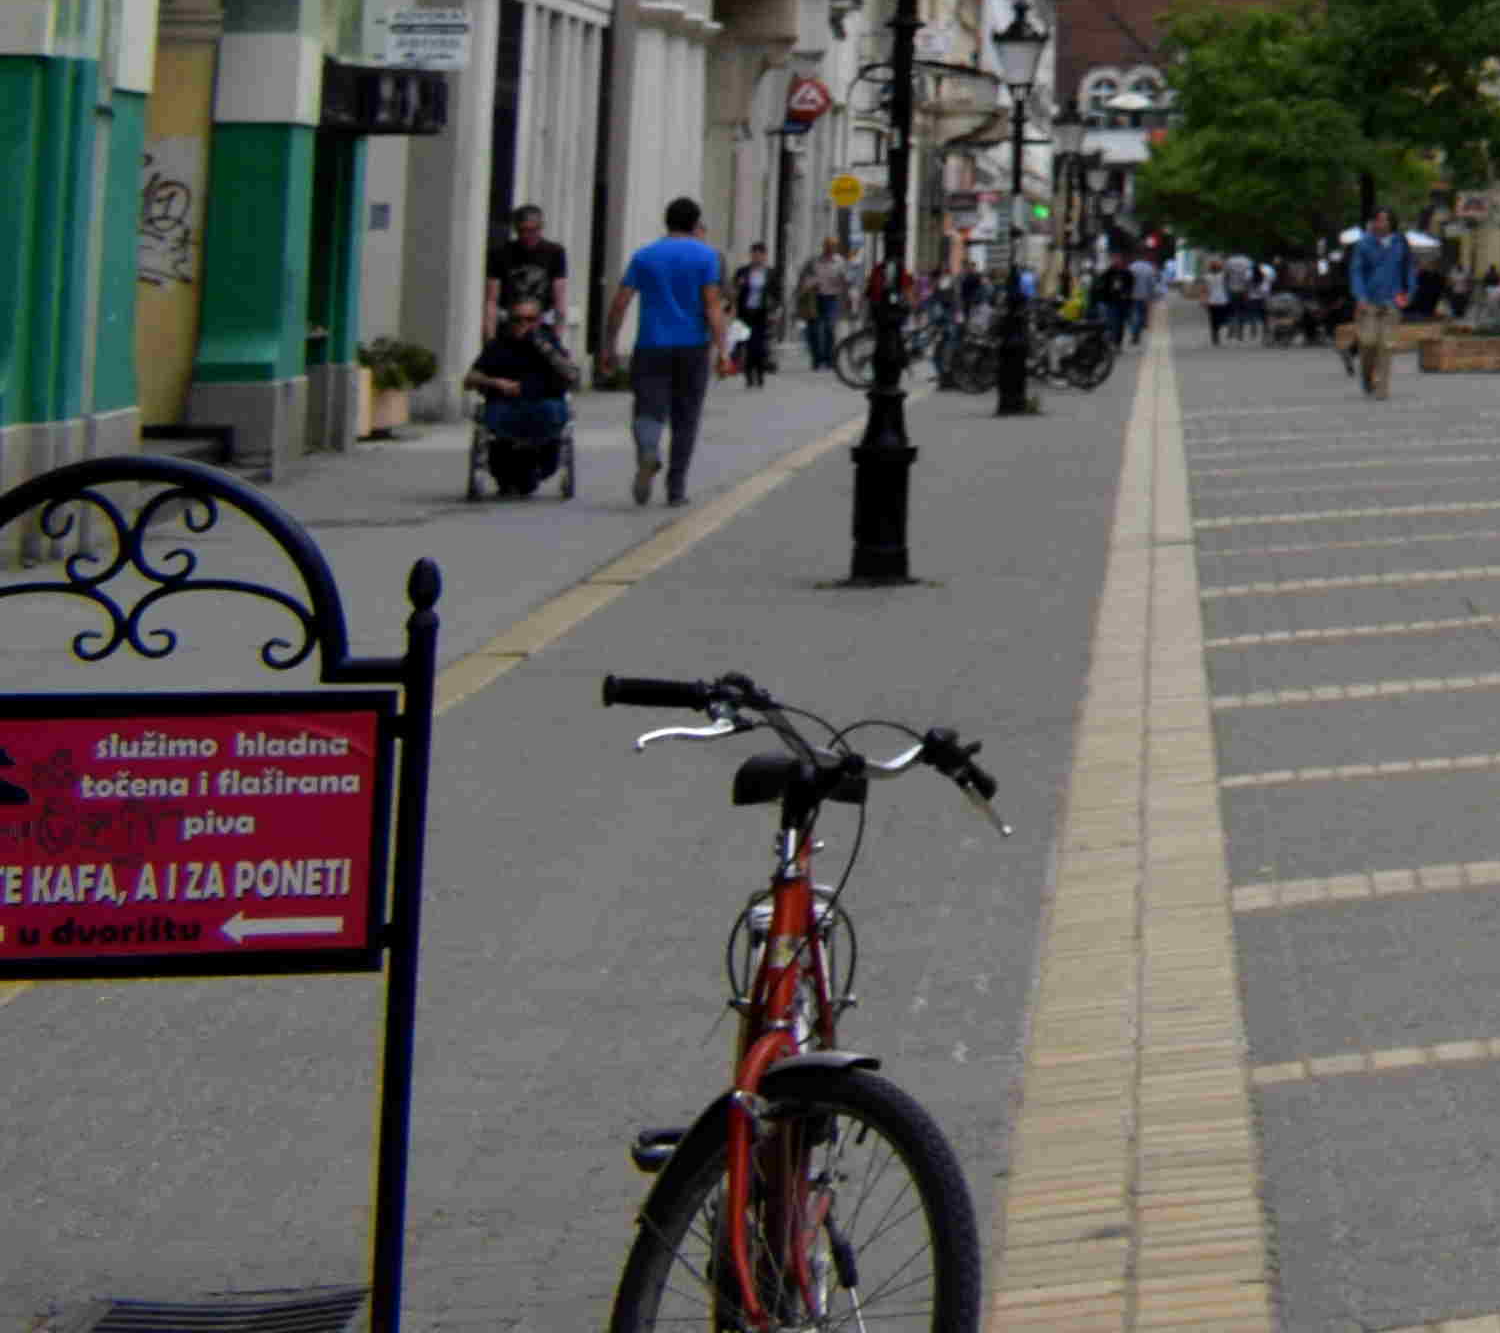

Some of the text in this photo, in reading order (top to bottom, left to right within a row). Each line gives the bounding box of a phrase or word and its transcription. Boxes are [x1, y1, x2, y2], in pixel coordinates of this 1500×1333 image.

[95, 732, 349, 758] služimo hladna
[80, 767, 360, 798] točena i flaširana
[182, 810, 256, 841] piva
[31, 863, 128, 907] KAFA,
[136, 862, 158, 900] A
[167, 862, 178, 900] I
[184, 861, 225, 899] ZA
[235, 858, 352, 899] PONETI
[18, 924, 41, 946] u
